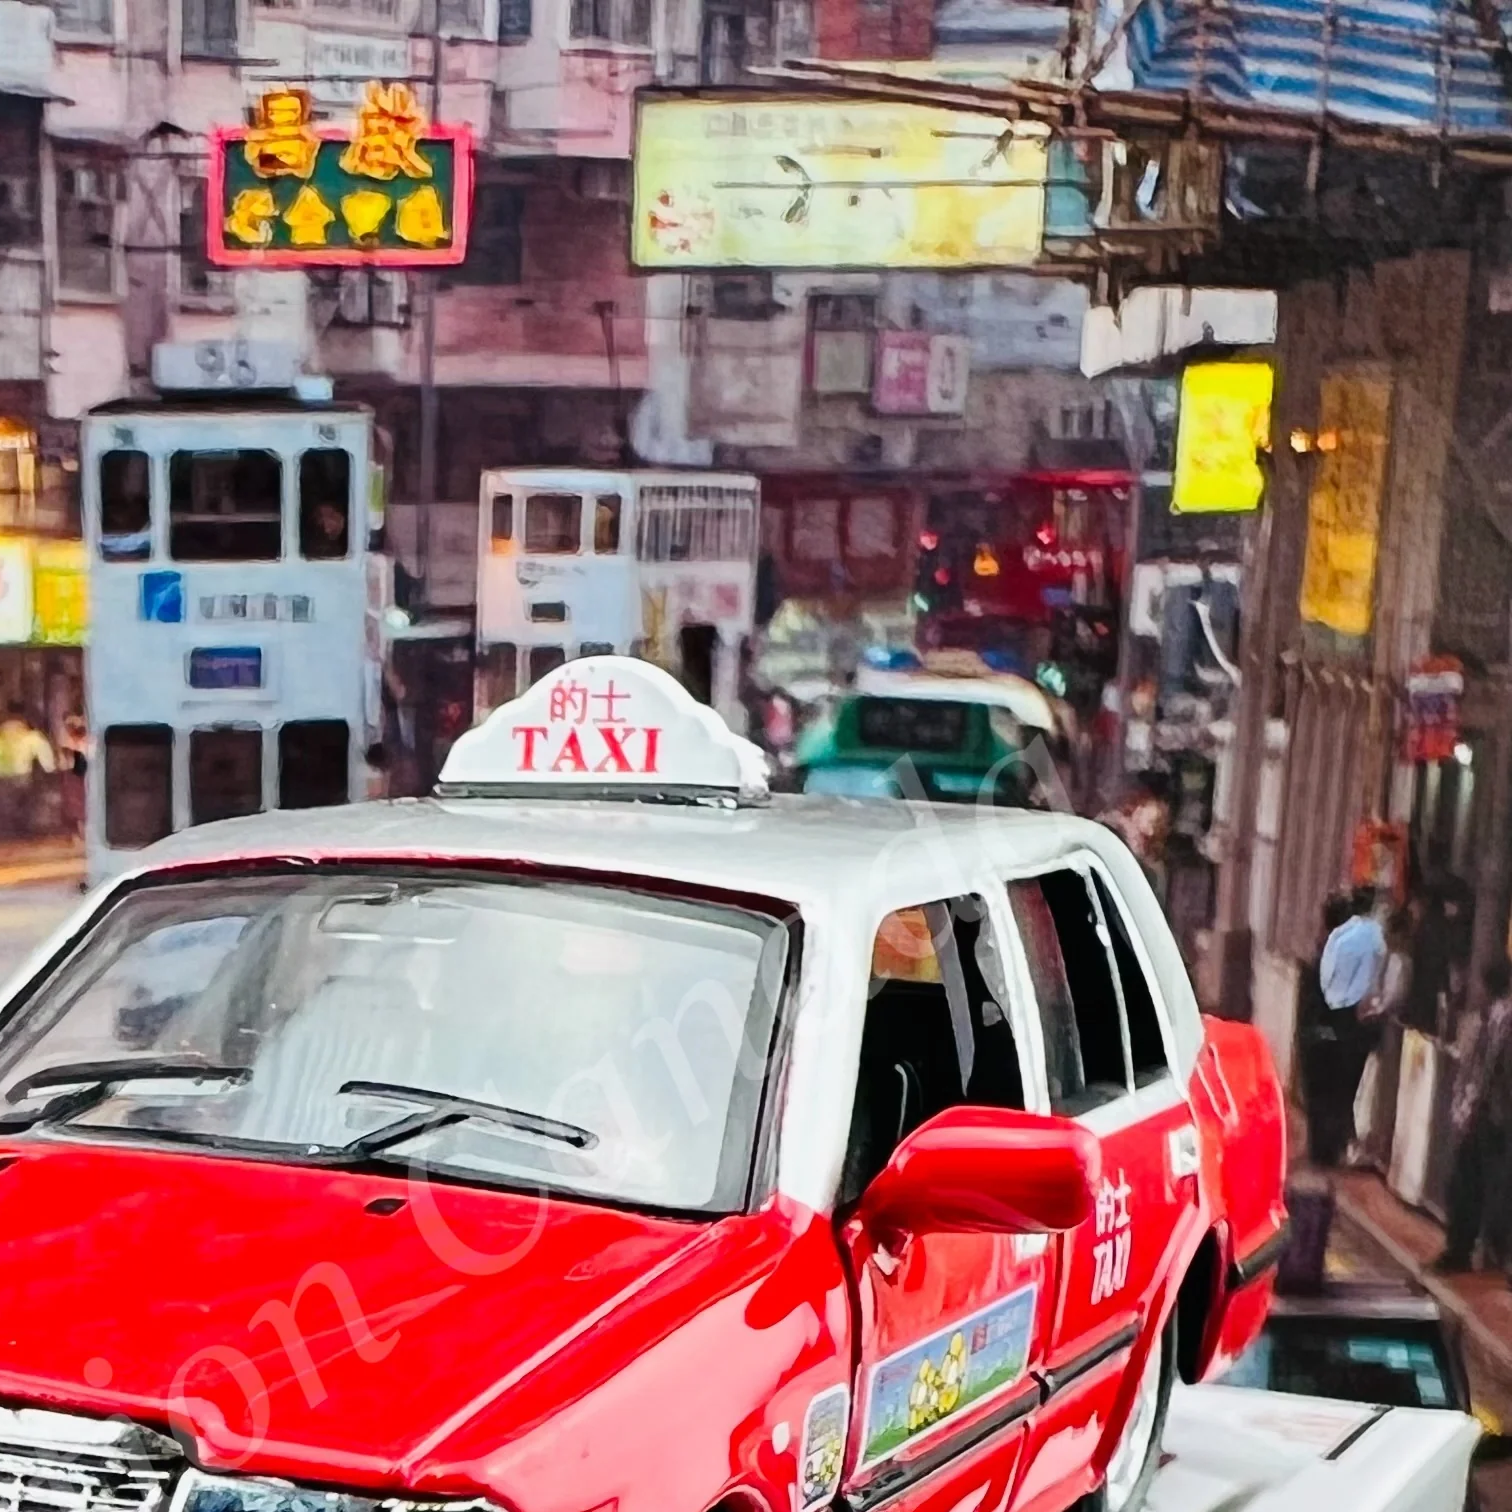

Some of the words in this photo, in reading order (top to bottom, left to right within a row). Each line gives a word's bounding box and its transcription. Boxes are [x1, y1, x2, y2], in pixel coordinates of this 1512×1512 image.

[549, 679, 632, 725] 的士
[511, 726, 663, 774] TAXI
[1090, 1227, 1133, 1306] TAXI
